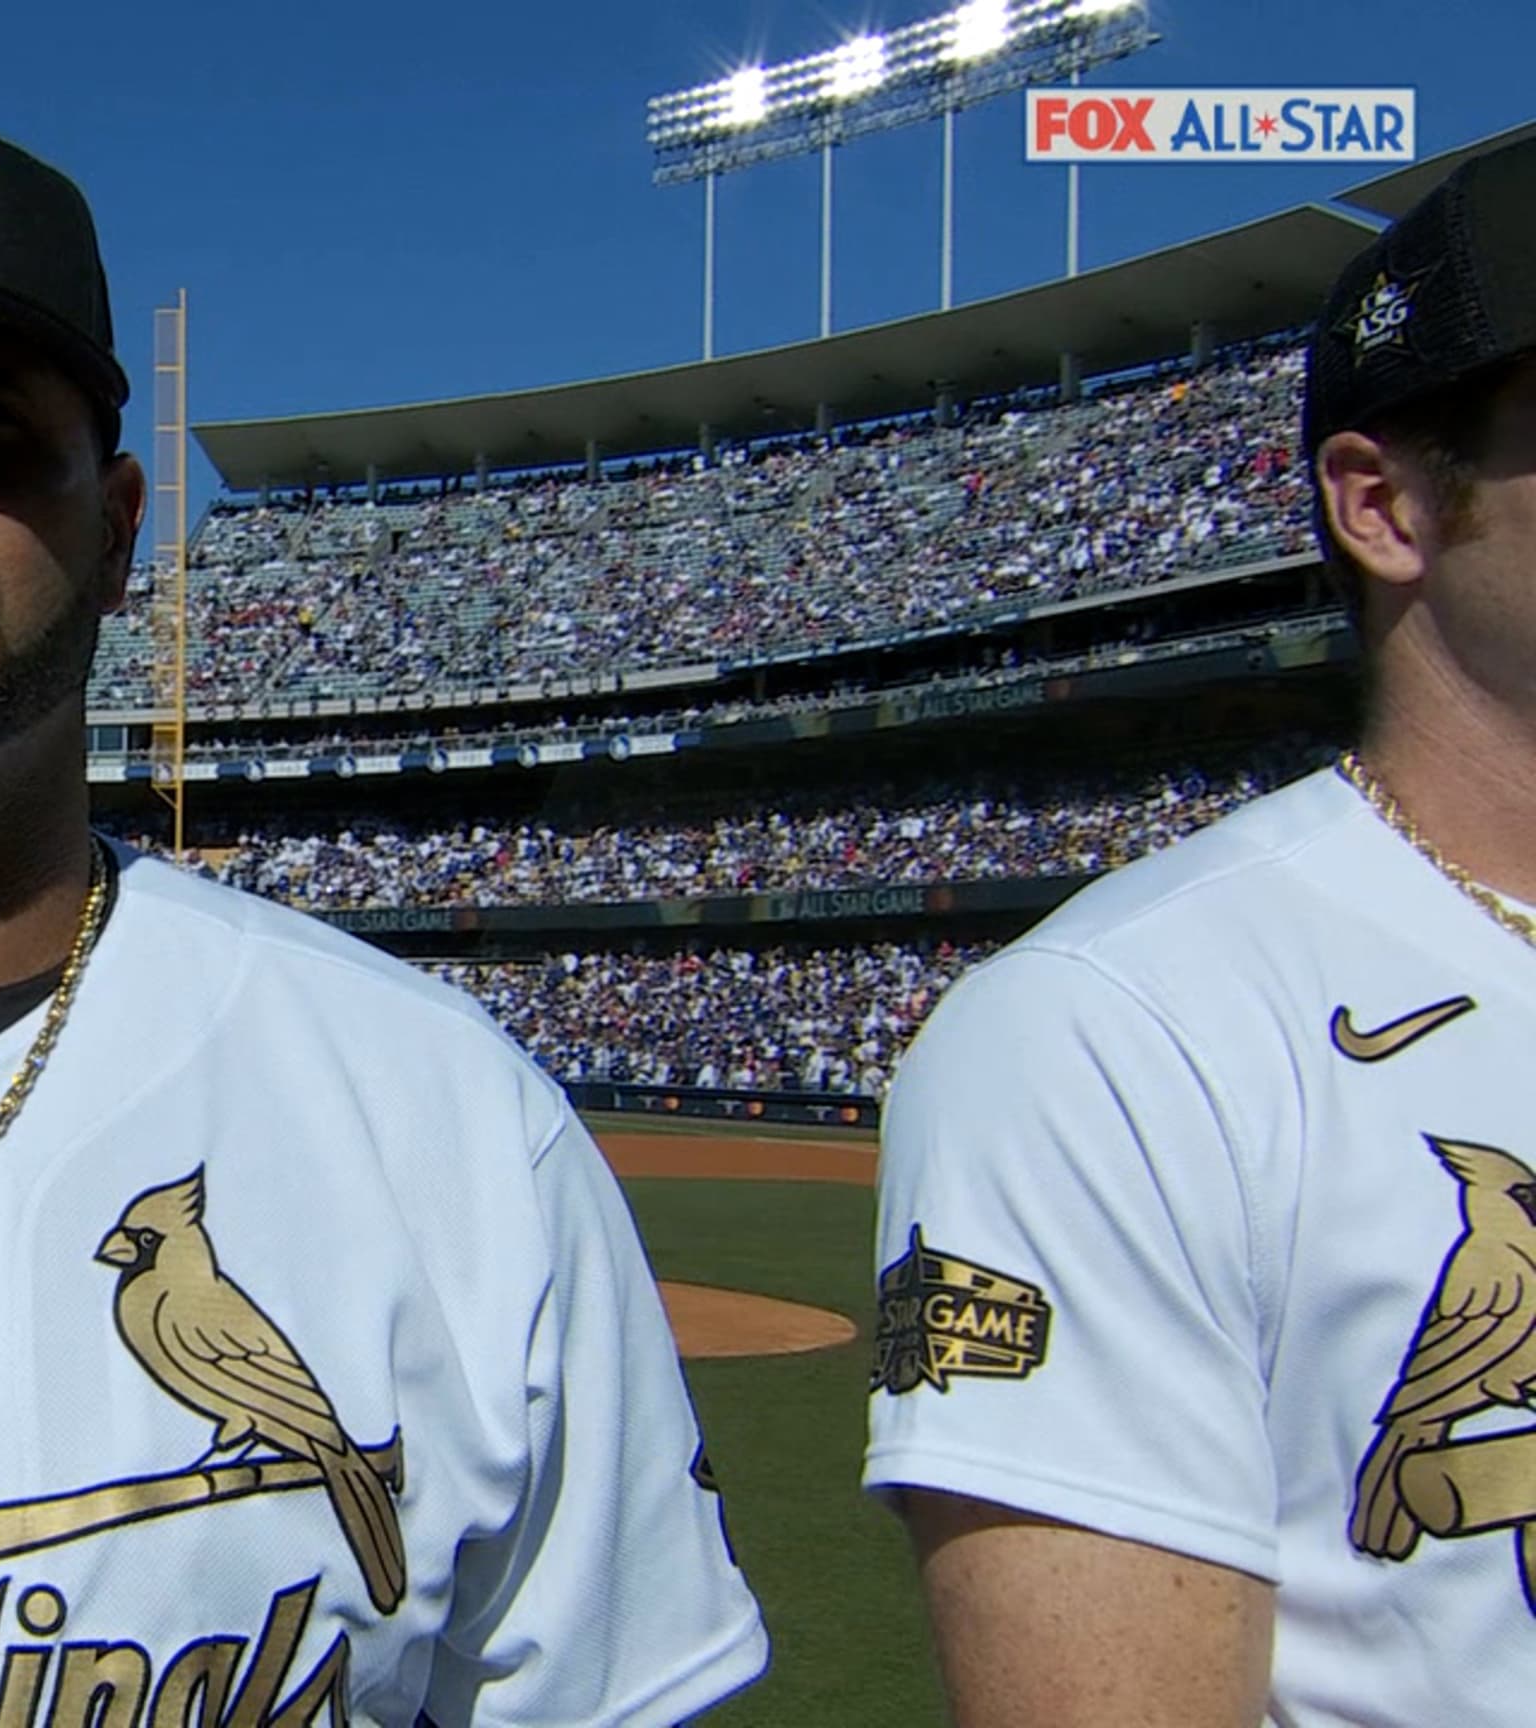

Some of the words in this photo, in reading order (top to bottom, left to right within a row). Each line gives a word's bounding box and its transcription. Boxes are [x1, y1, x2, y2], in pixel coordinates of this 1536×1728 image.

[1355, 297, 1408, 344] ASG
[358, 911, 399, 931] STAR
[402, 910, 452, 931] GAME
[831, 891, 870, 917] STAR
[872, 888, 924, 914] GAME
[924, 1293, 1037, 1348] GAME
